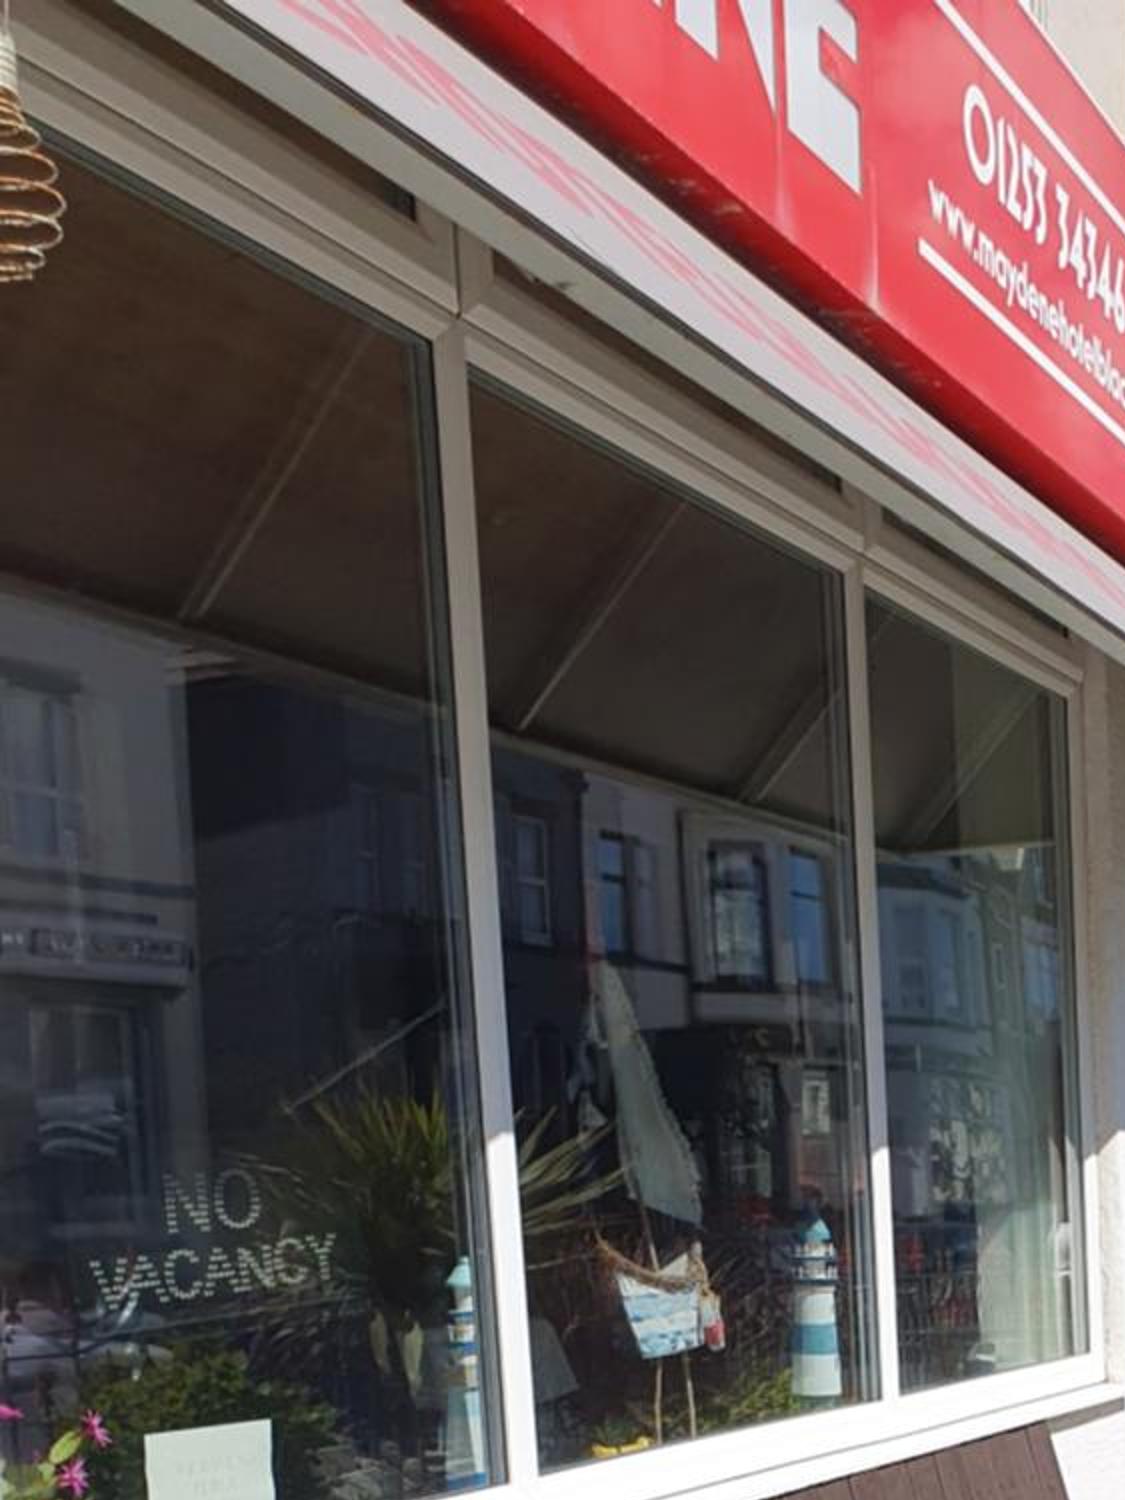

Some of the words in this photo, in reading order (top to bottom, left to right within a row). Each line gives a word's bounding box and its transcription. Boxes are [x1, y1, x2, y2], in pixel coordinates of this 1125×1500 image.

[963, 85, 1047, 245] 01253
[163, 1169, 261, 1233] NO
[90, 1233, 336, 1310] VACANCY
